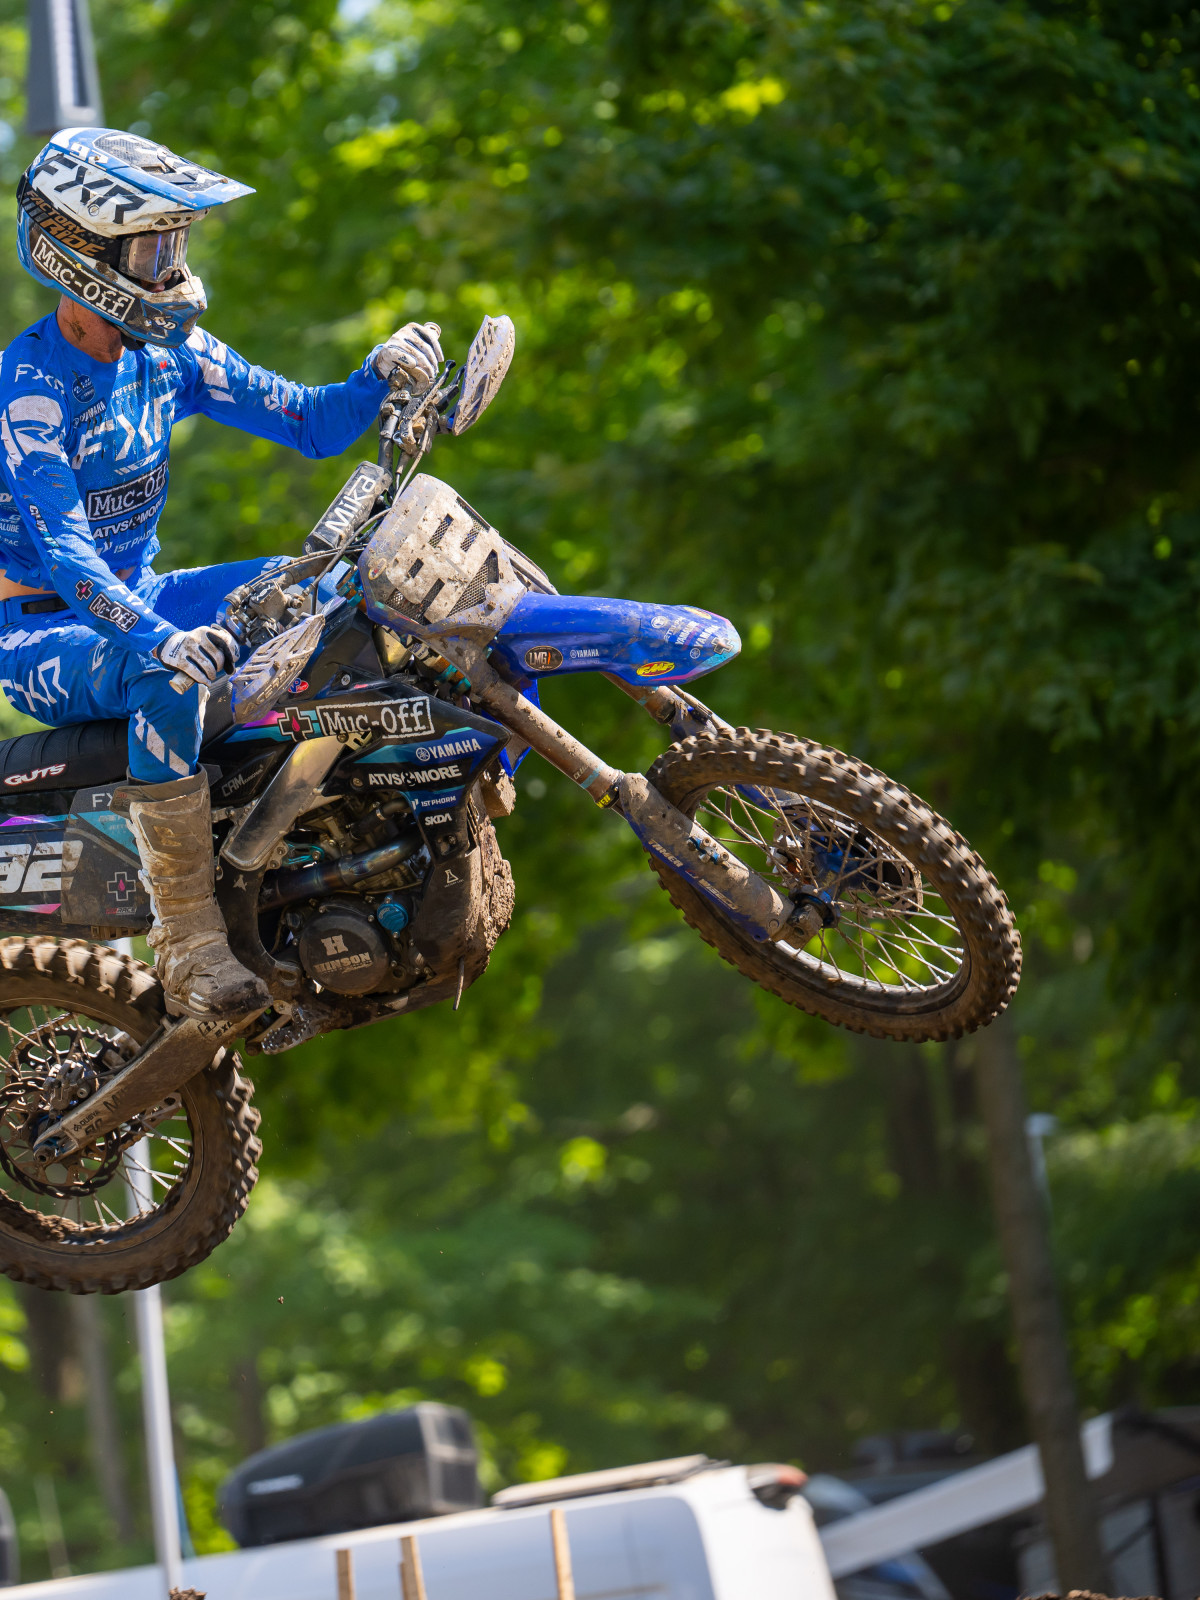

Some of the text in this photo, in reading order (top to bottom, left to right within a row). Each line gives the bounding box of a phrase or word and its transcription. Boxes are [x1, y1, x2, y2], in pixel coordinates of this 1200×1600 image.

[33, 152, 146, 225] FXR
[26, 190, 86, 235] FACTORY
[576, 648, 600, 658] YAMAHA
[428, 738, 482, 759] YAMAHA
[4, 763, 67, 786] GUTS
